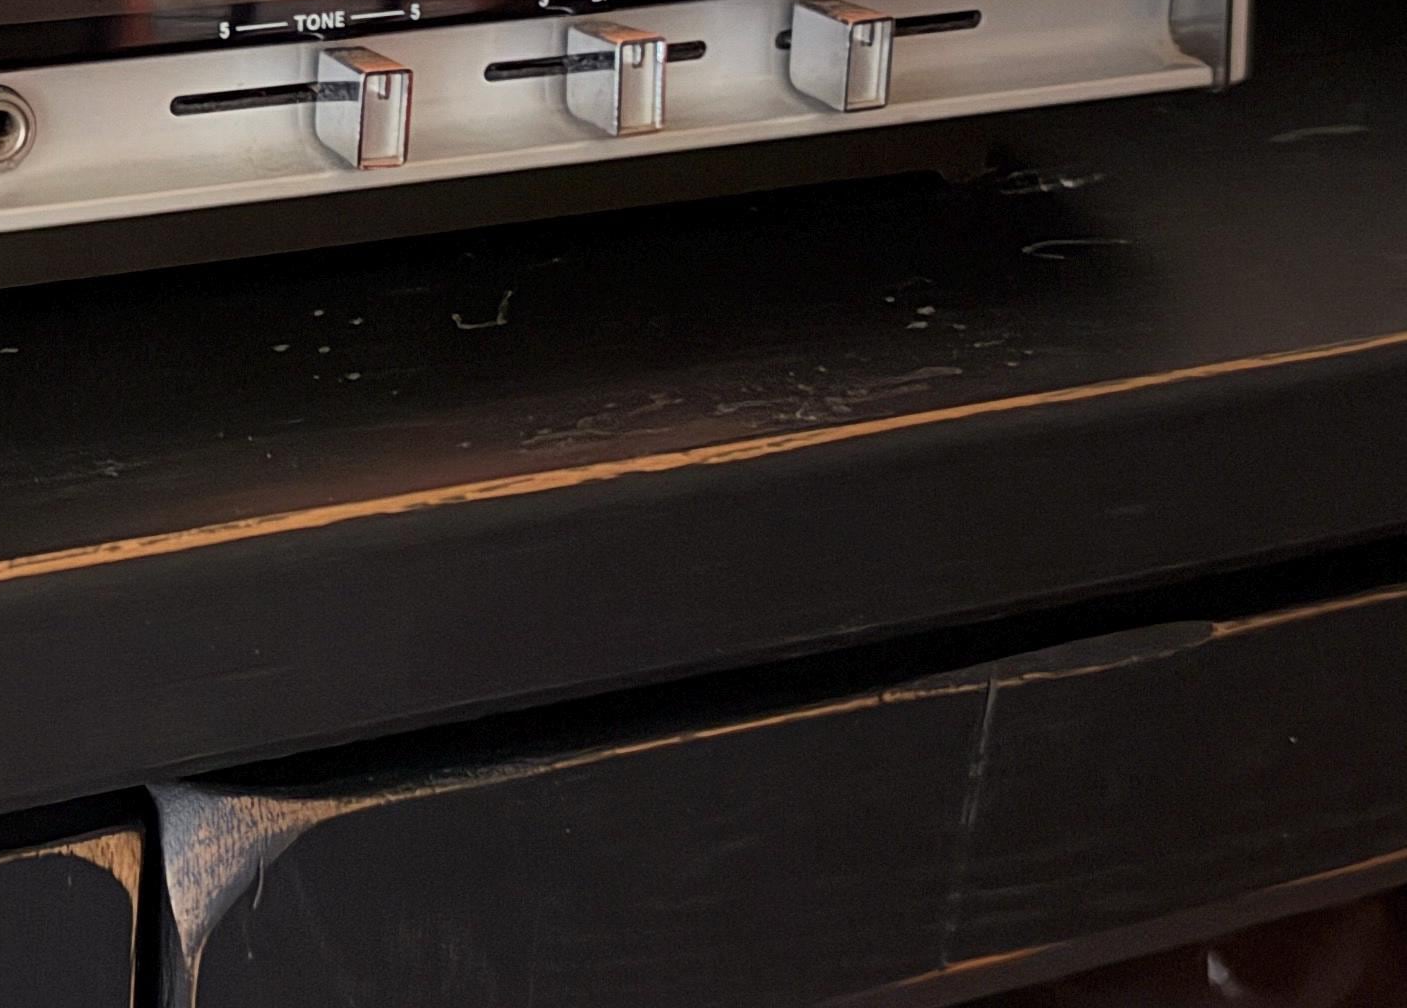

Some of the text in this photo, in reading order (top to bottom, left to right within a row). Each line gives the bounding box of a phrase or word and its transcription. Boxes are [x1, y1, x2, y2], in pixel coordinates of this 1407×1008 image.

[219, 4, 421, 40] 5 TONE 5
